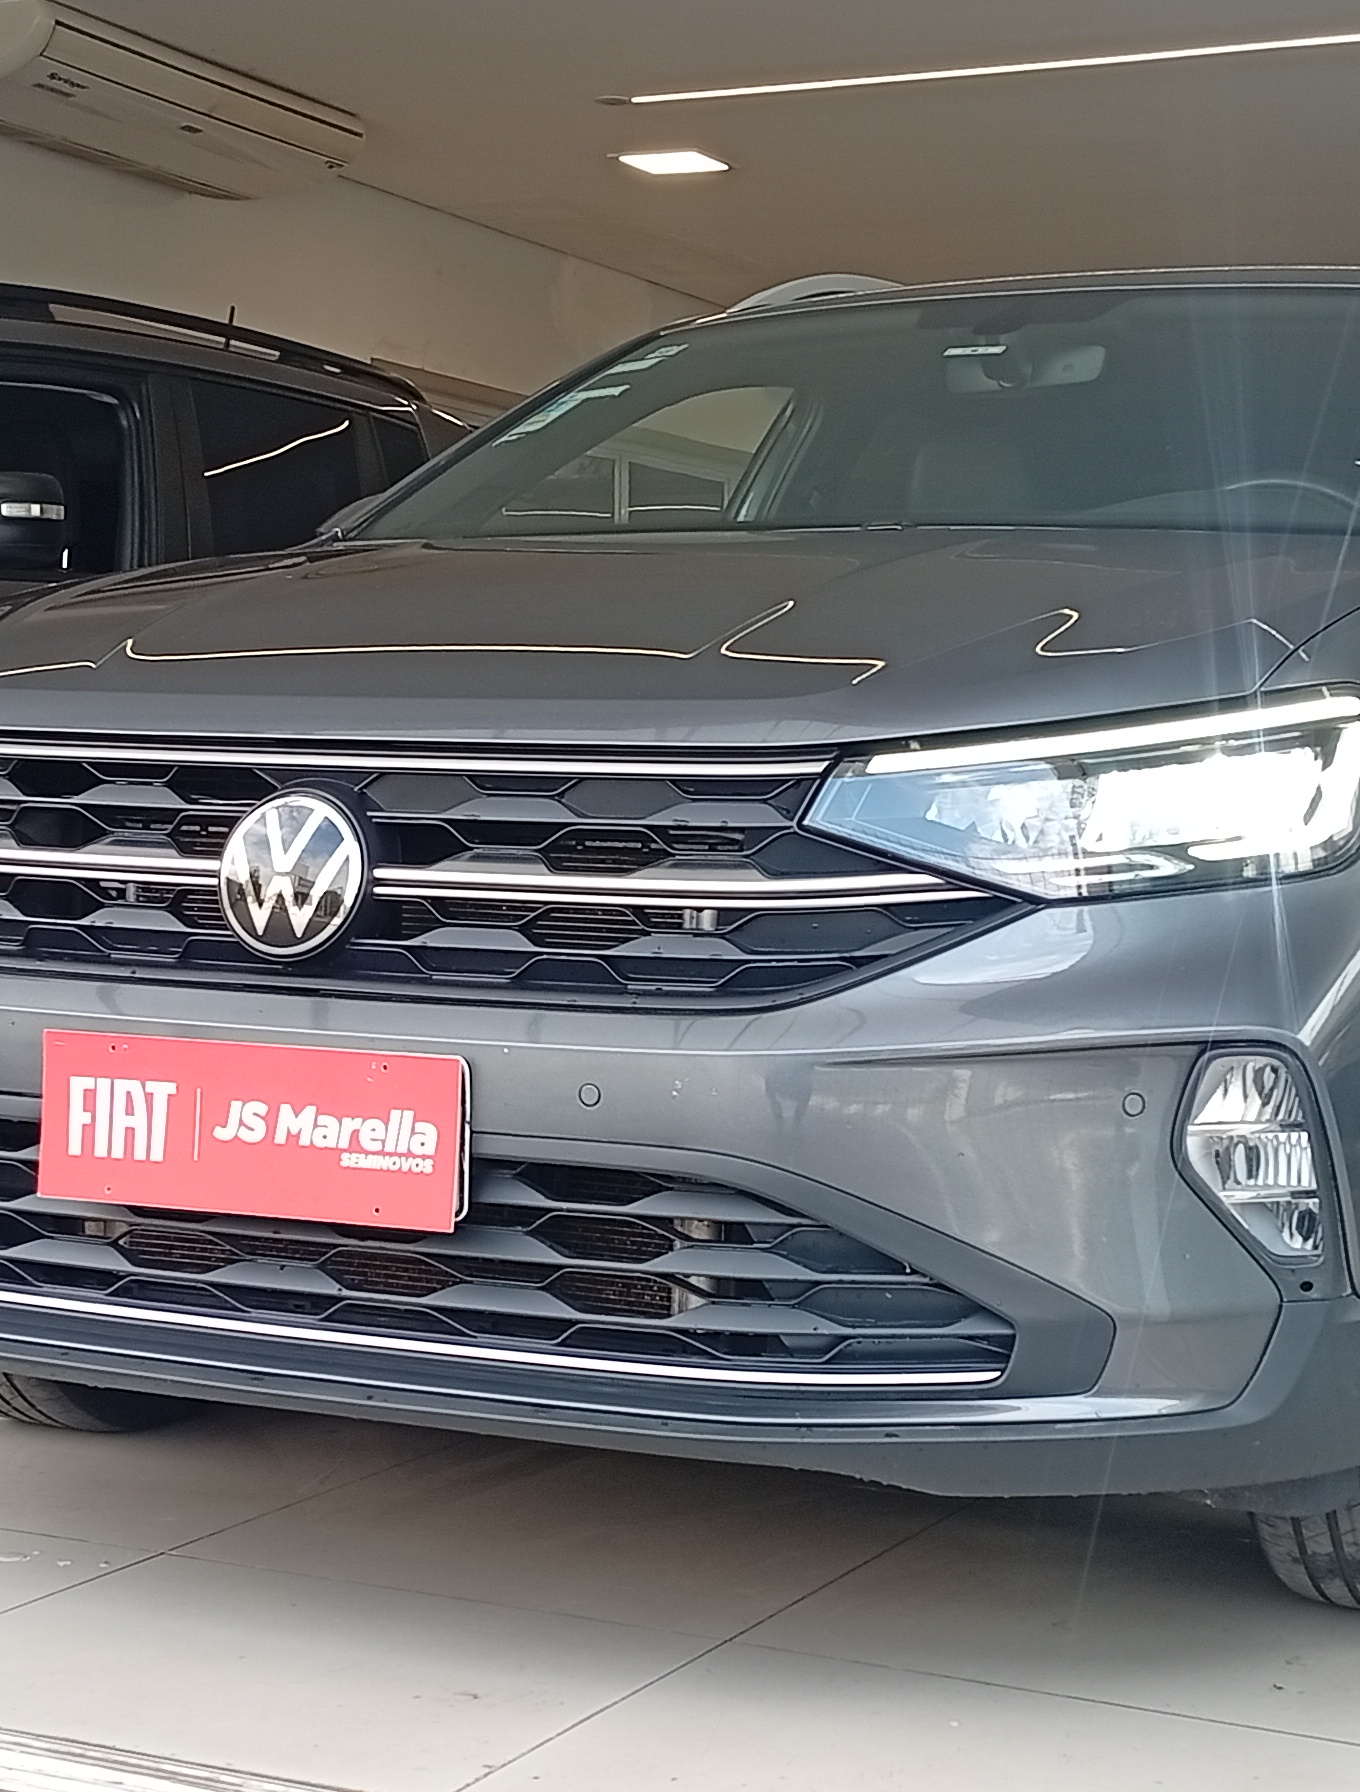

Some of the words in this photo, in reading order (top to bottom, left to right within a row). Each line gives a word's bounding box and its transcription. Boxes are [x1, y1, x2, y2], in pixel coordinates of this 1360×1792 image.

[68, 1076, 177, 1162] FIAT
[213, 1100, 268, 1143] JS
[274, 1103, 438, 1156] Marella
[340, 1152, 434, 1174] SEMINOVOS
